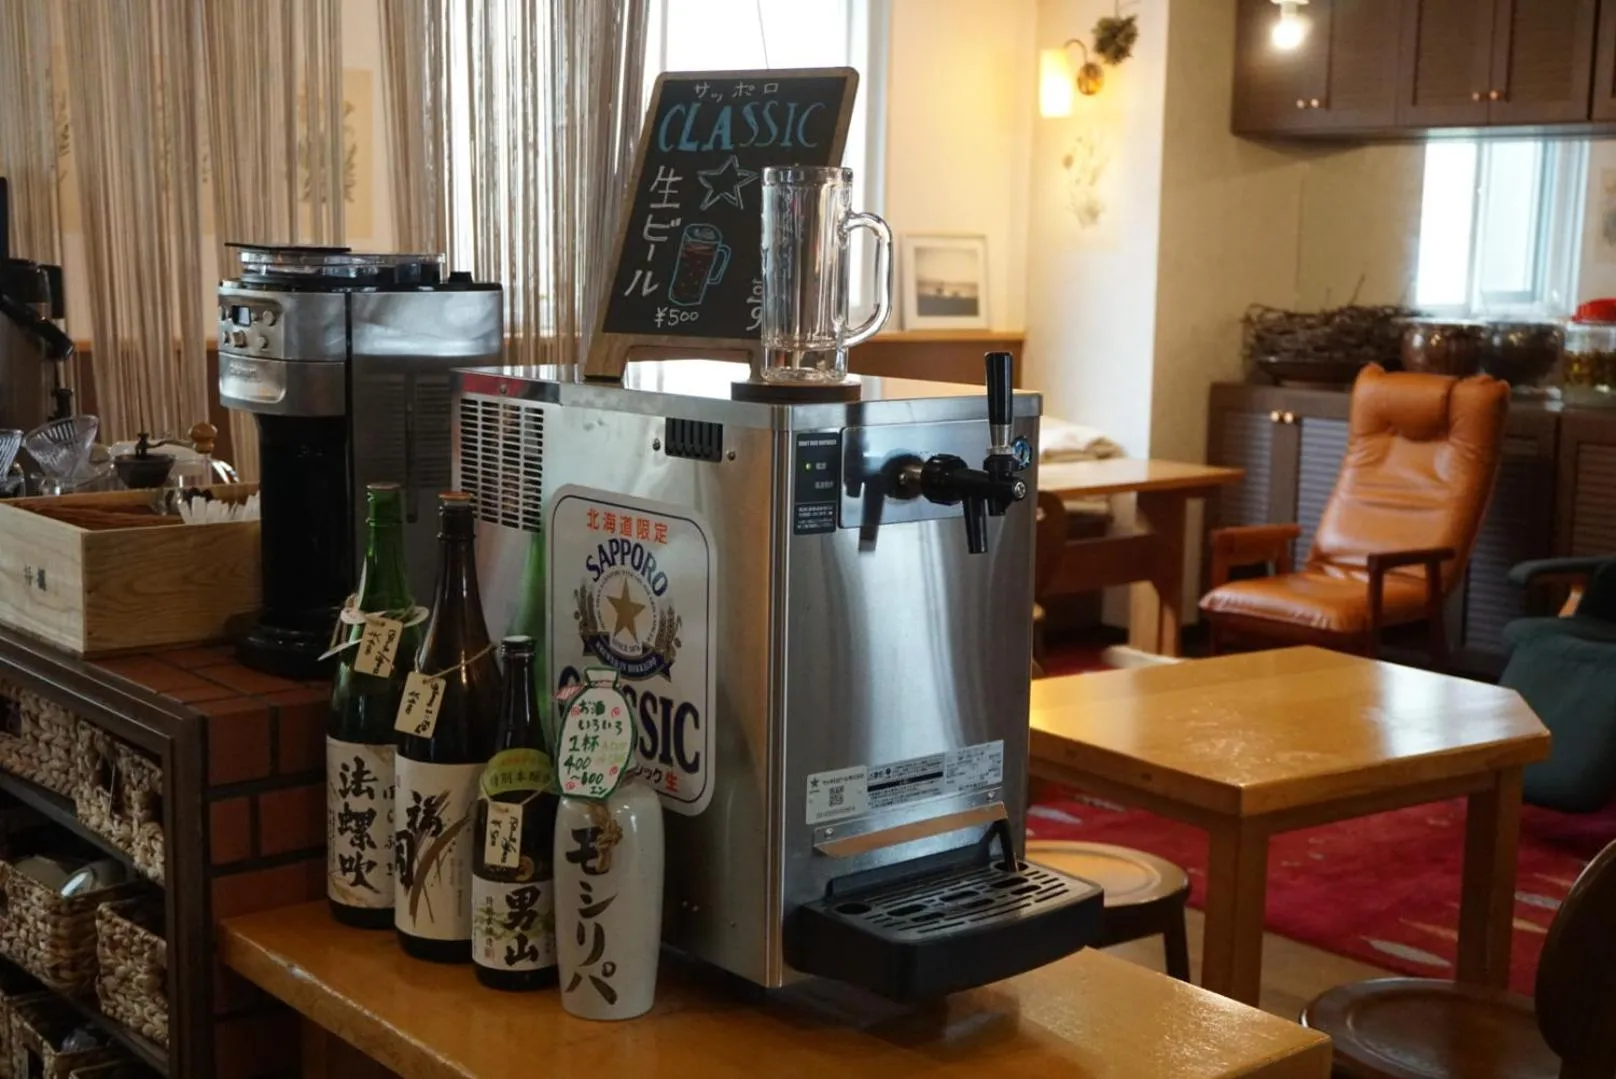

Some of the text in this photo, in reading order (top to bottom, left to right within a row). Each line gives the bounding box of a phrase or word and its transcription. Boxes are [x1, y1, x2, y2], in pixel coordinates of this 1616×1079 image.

[694, 82, 779, 102] サッポロ
[658, 102, 825, 152] CLASSIC
[624, 166, 683, 297] 生ビール
[654, 307, 700, 328] ¥500
[586, 508, 668, 545] 北海道限定
[586, 538, 668, 597] SAPPORO
[578, 719, 623, 735] いろいろ
[564, 755, 592, 774] 400
[503, 885, 541, 967] 男山
